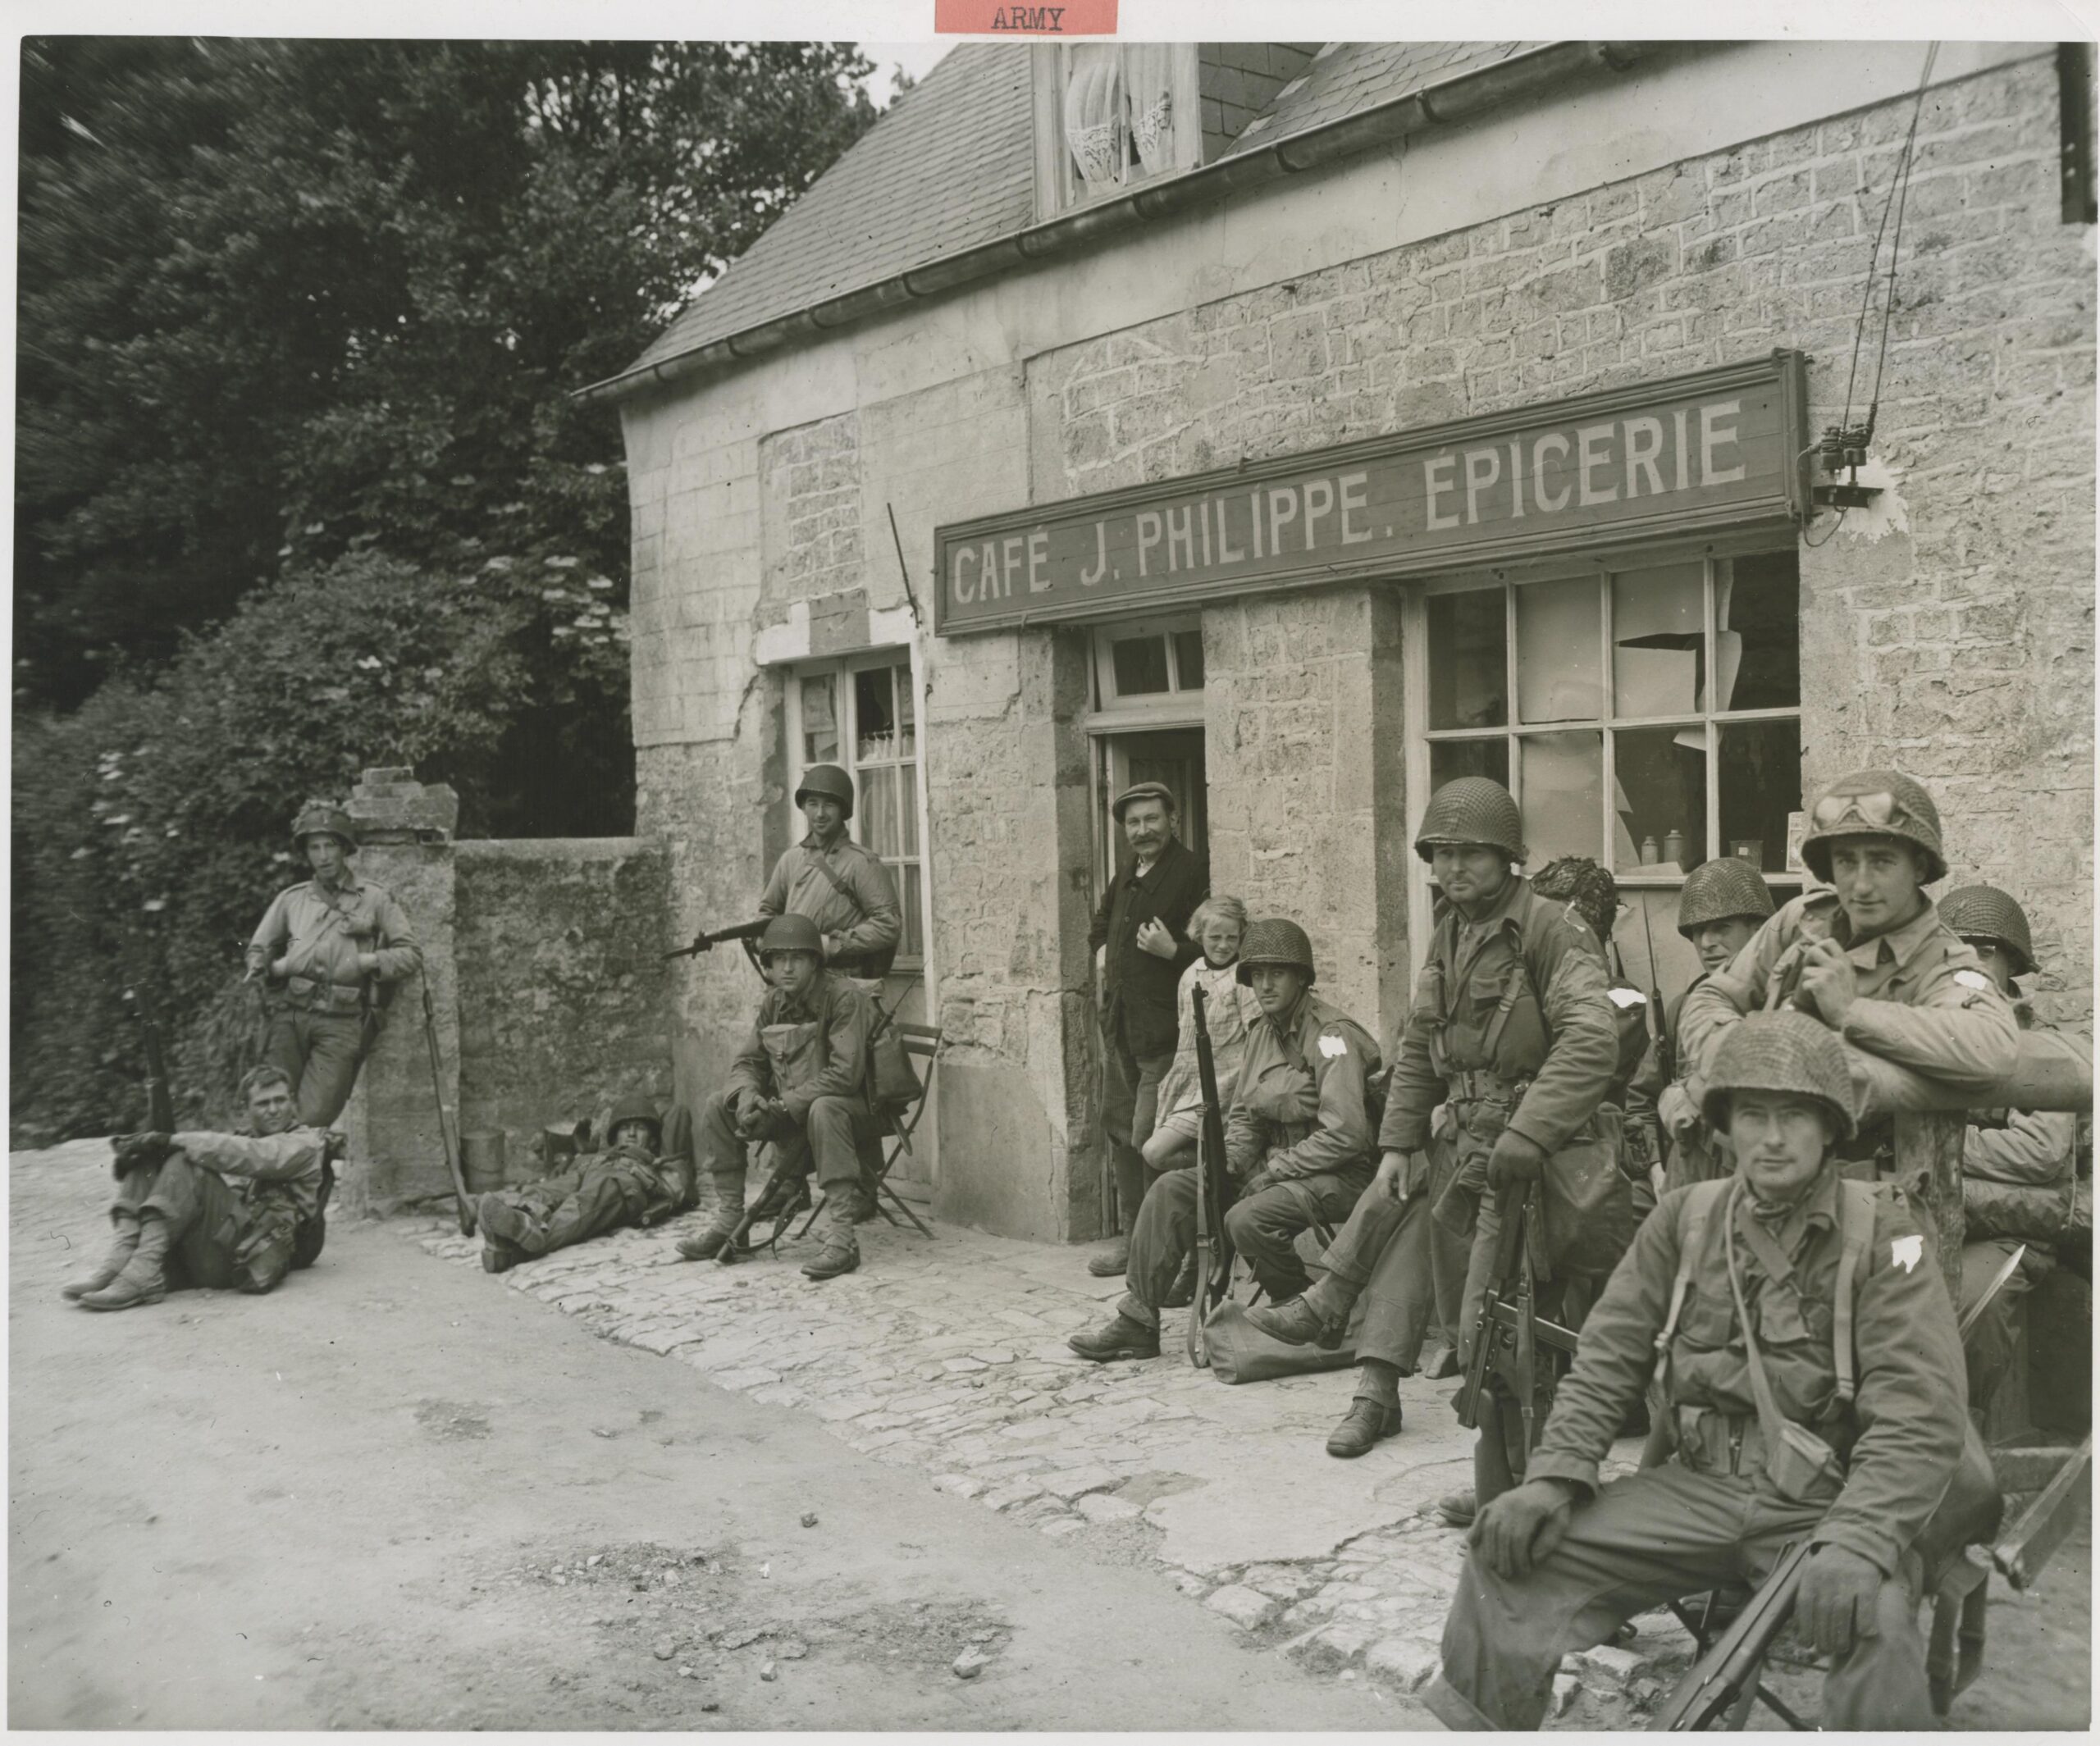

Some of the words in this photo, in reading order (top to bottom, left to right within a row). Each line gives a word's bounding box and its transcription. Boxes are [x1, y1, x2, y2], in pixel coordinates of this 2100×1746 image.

[953, 525, 1052, 605] CAFÉ
[1080, 521, 1121, 586] J.
[1135, 471, 1393, 577] PHILIPPE.
[1423, 399, 1746, 531] ÉPICERIE
